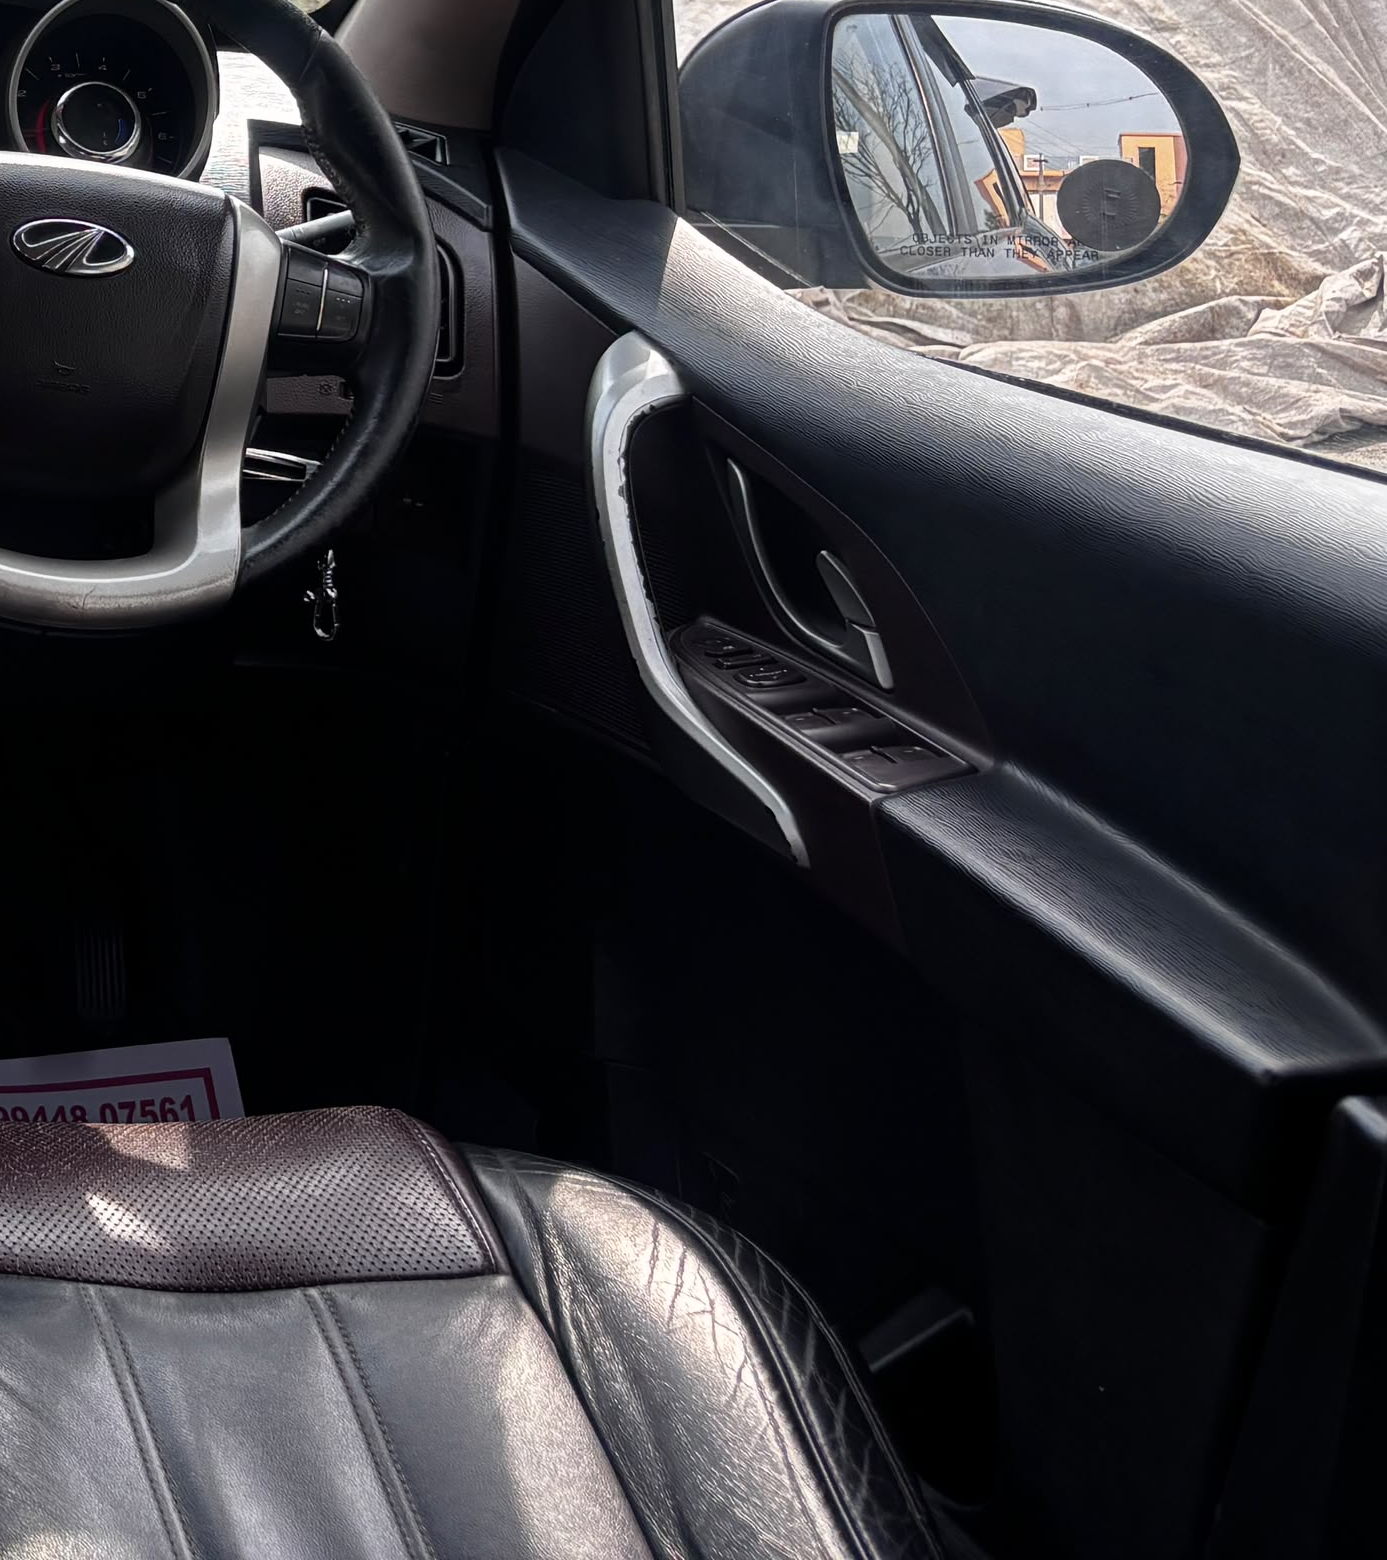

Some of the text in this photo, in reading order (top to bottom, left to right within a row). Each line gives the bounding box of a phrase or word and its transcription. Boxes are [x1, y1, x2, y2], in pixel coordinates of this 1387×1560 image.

[912, 233, 972, 245] OBJECTS
[982, 235, 999, 245] IN
[1007, 235, 1058, 247] MIRROR
[900, 246, 1100, 261] CLOSER THAN THEY APPEAR
